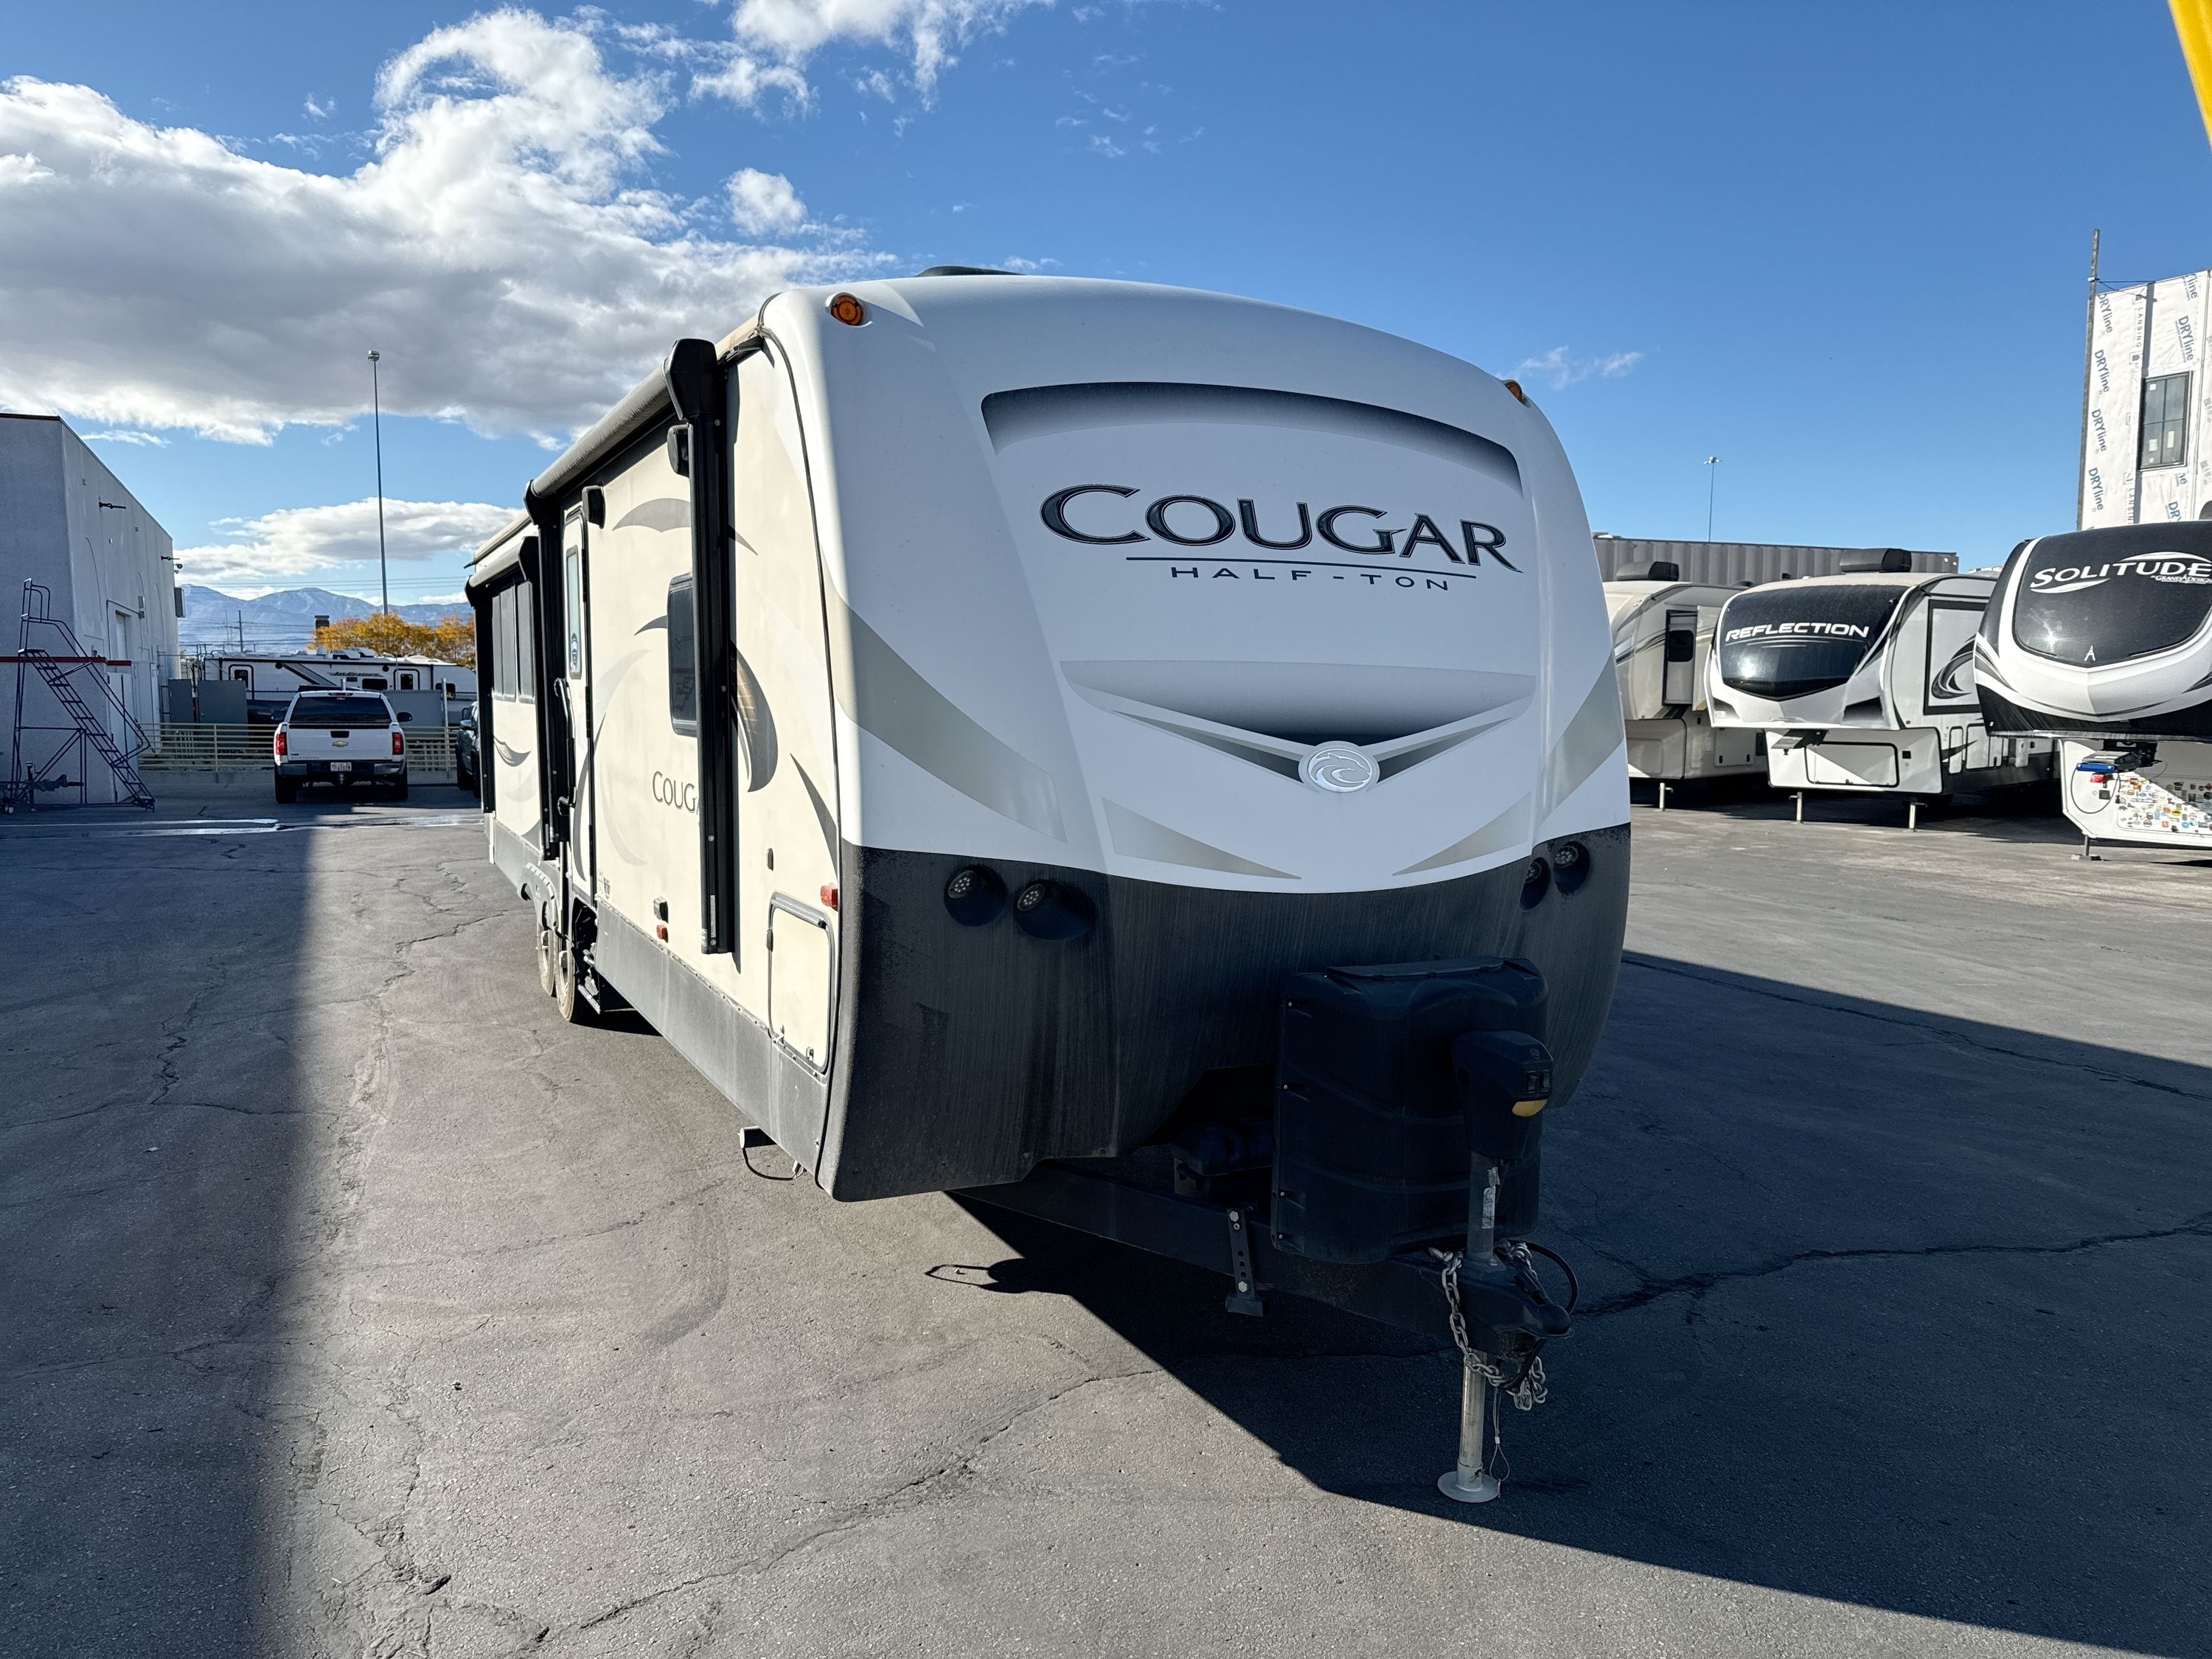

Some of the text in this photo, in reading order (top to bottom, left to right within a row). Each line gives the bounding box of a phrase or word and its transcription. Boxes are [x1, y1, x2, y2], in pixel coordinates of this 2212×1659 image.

[2177, 315, 2194, 361] DRYline
[2094, 349, 2110, 393] DRYline
[2091, 408, 2107, 452] DRYline
[2088, 467, 2104, 511] DRYline
[1040, 484, 1523, 574] COUGAR
[2030, 561, 2212, 588] SOLITUDE
[1725, 622, 1870, 642] REFLECTION
[653, 771, 699, 815] COUG
